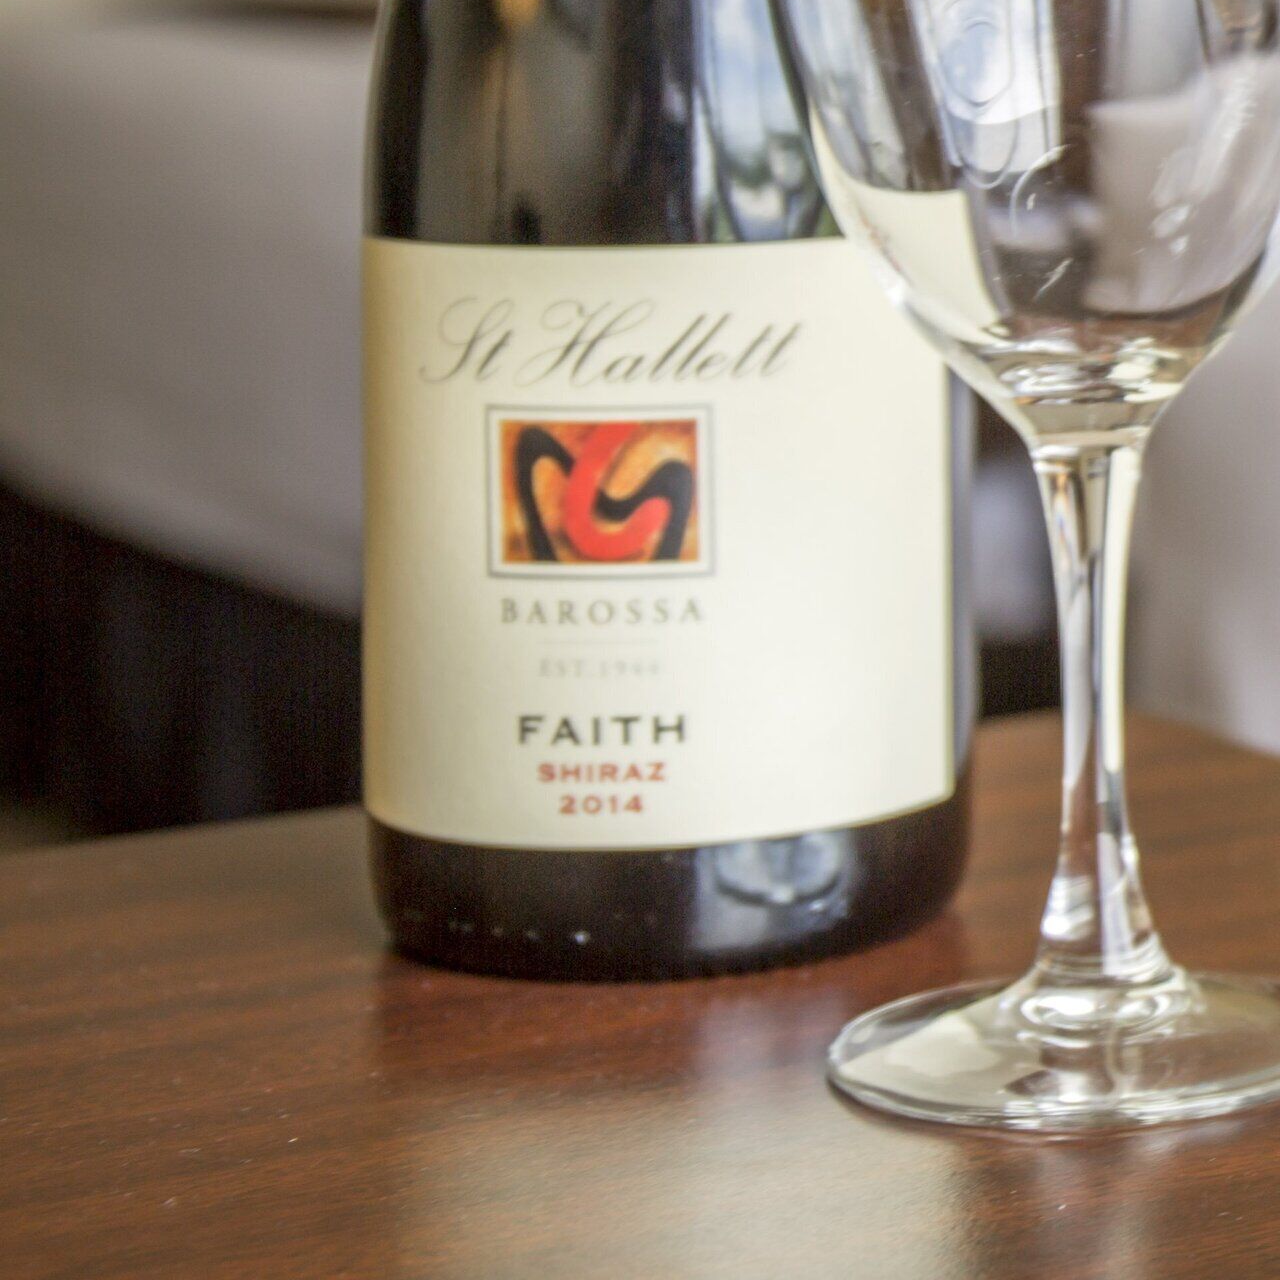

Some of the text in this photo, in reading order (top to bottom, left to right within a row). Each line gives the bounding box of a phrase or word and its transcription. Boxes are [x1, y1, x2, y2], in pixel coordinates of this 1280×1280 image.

[418, 295, 804, 389] St Hallett
[500, 597, 703, 625] BAROSSA
[517, 714, 687, 746] FAITH
[536, 761, 666, 783] SHIRAZ
[558, 794, 644, 815] 2014
